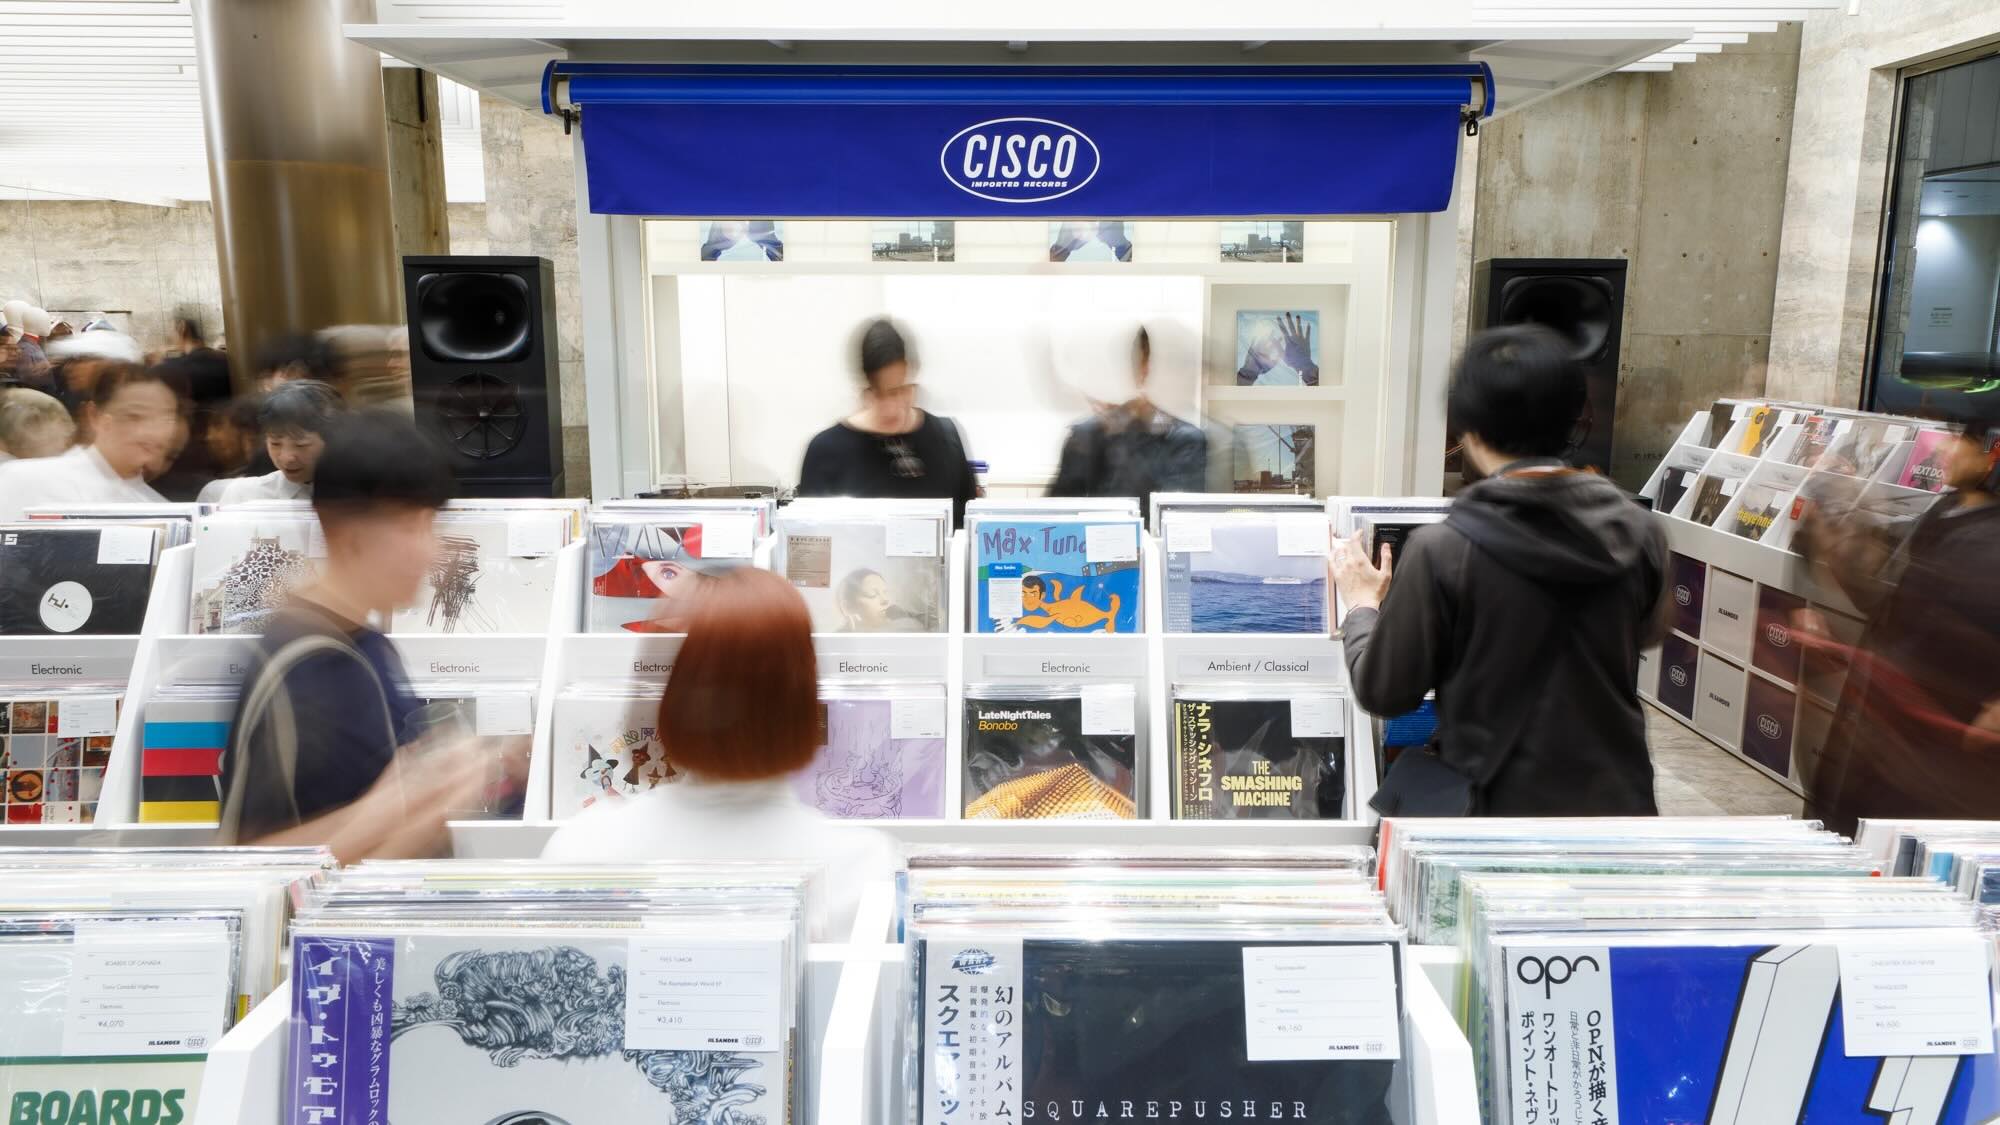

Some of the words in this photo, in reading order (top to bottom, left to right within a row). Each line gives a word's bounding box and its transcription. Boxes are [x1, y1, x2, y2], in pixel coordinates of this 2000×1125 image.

[963, 134, 1077, 178] CISCO
[1910, 465, 1931, 476] NEXT
[983, 527, 1032, 560] Max
[1675, 586, 1690, 603] CISCO
[1768, 624, 1790, 643] CISCO
[31, 663, 83, 676] Electronic
[429, 661, 480, 674] Electronic
[633, 660, 675, 673] Electron
[838, 661, 889, 674] Electronic
[1041, 661, 1091, 674] Electronic
[1207, 660, 1251, 672] Ambient
[1264, 660, 1309, 672] Classical
[1671, 667, 1686, 682] CISCO
[978, 710, 1051, 720] LateNightTales
[978, 720, 1018, 731] Bonobo
[1759, 717, 1778, 734] CISCO
[1196, 703, 1213, 801] ナラ・シネフロ
[1252, 760, 1270, 775] THE
[1220, 775, 1303, 791] SMASHING
[1232, 791, 1291, 807] MACHINE
[10, 1089, 185, 1125] BOARDS
[1023, 1100, 1306, 1120] SQUAREPUSHER
